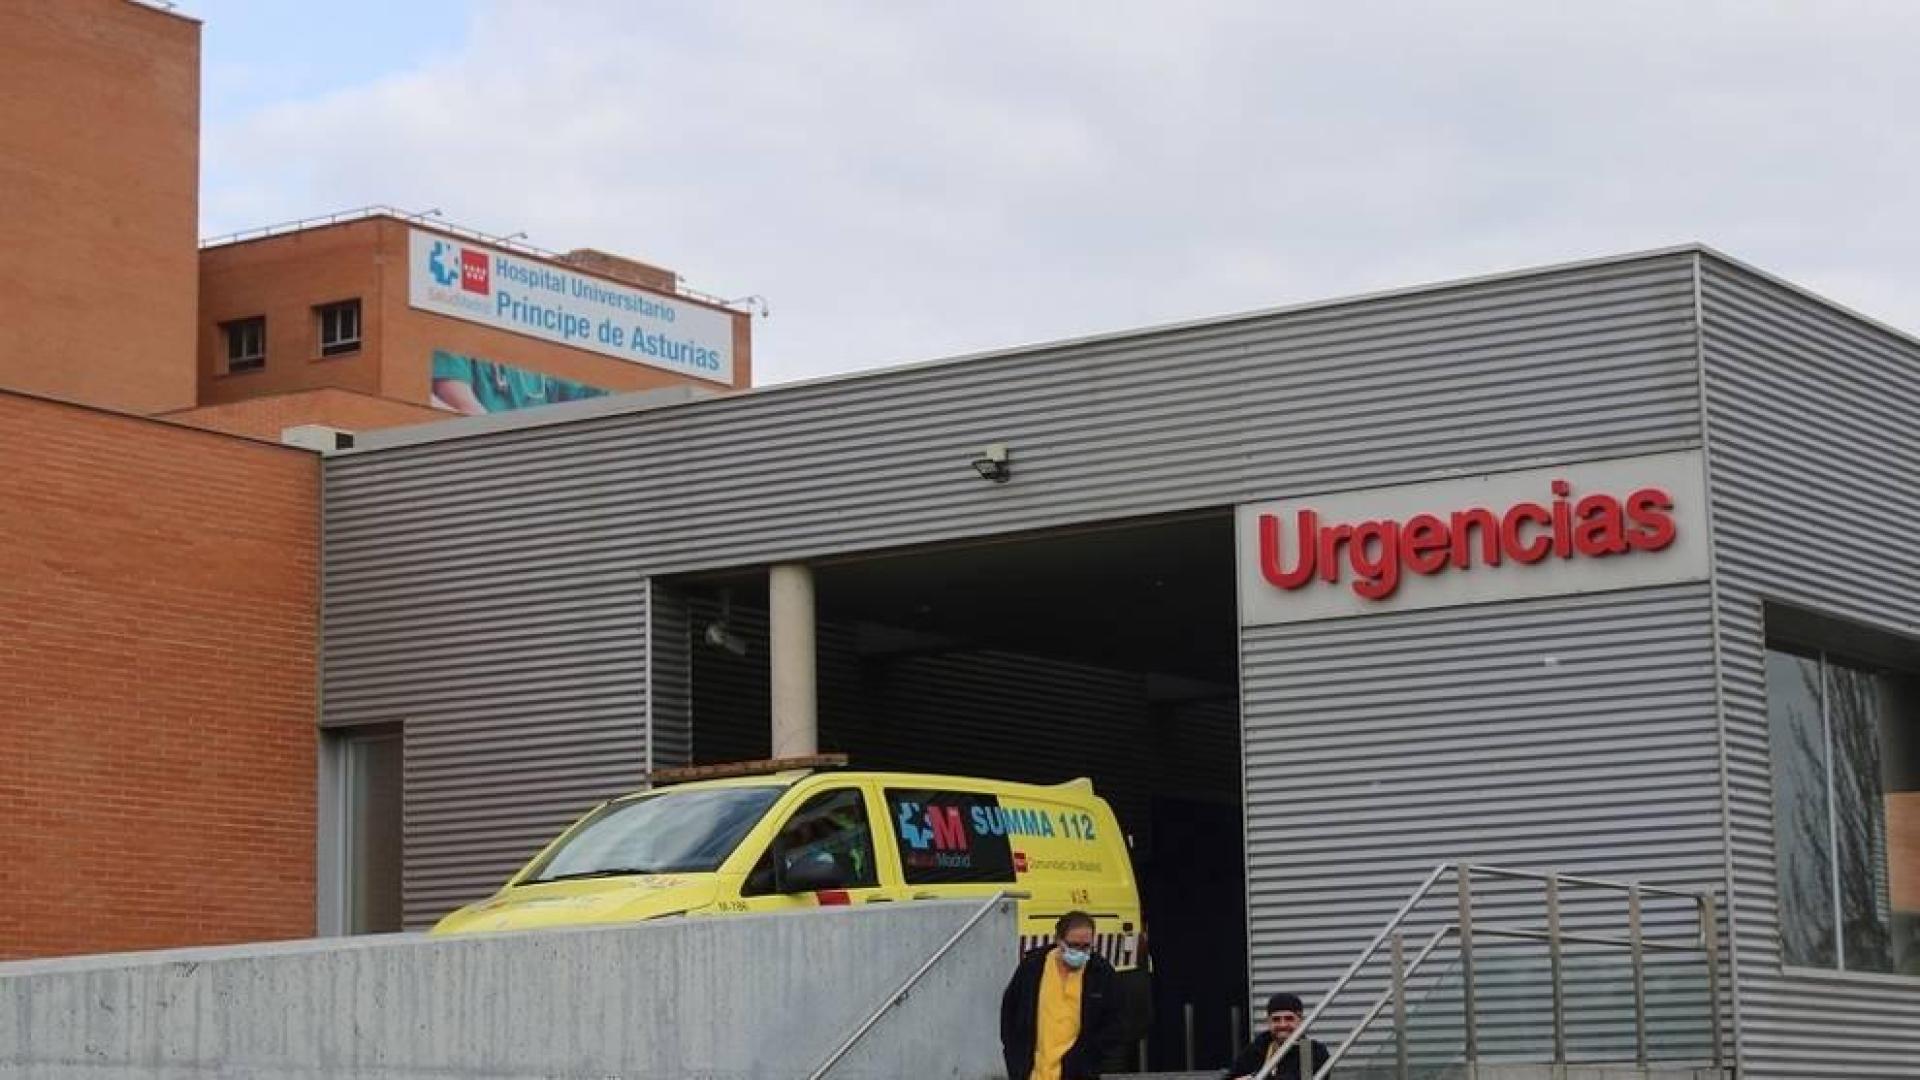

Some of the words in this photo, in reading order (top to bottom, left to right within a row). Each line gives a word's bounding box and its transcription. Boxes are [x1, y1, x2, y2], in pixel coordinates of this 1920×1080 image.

[496, 256, 566, 295] Hospital
[571, 279, 676, 322] Universitario
[598, 318, 624, 348] de
[631, 325, 720, 371] Asturias
[1258, 480, 1677, 600] Urgencias
[971, 805, 1056, 838] SUMMA
[1058, 812, 1096, 841] 112
